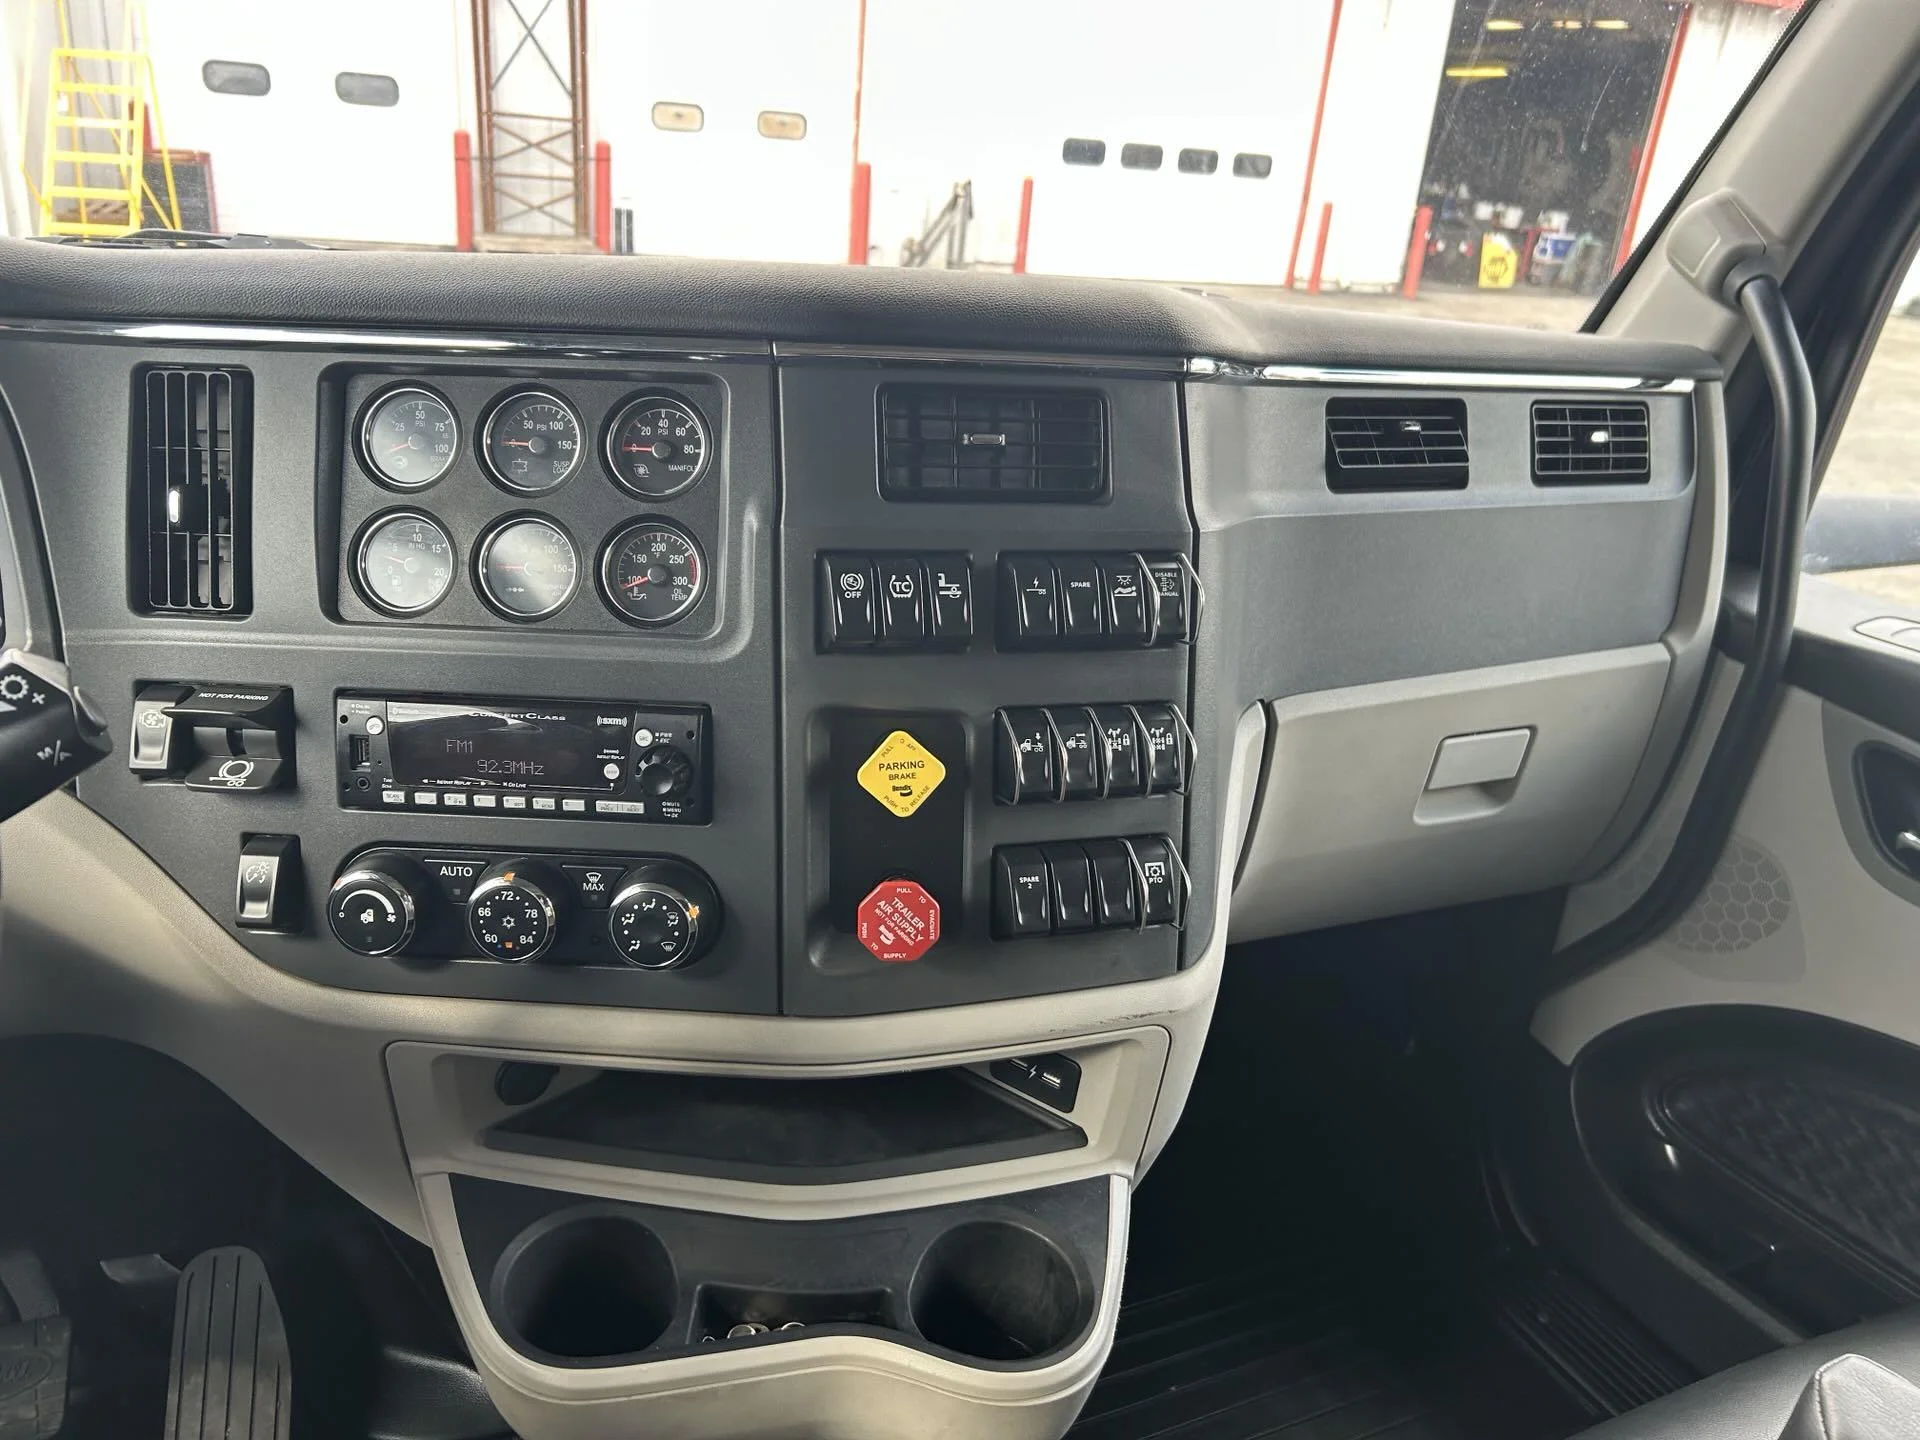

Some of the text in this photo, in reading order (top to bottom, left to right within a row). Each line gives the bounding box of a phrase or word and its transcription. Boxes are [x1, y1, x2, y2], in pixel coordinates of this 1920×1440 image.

[416, 410, 425, 419] 50
[394, 422, 405, 431] 25
[434, 422, 445, 431] 75
[523, 420, 533, 429] 50
[549, 421, 564, 430] 100
[658, 419, 669, 428] 40
[641, 426, 651, 436] 20
[657, 428, 669, 436] PSI
[675, 427, 686, 436] 60
[434, 444, 449, 453] 100
[557, 440, 572, 450] 150
[683, 444, 694, 454] 80
[412, 533, 422, 542] 10
[431, 544, 441, 553] 15
[543, 545, 559, 554] 100
[651, 543, 666, 552] 200
[632, 554, 647, 563] 150
[669, 555, 684, 564] 250
[433, 567, 444, 576] 20
[553, 564, 568, 573] 150
[672, 576, 688, 585] 300
[1070, 581, 1091, 589] SPARE
[893, 581, 910, 592] TC
[845, 590, 862, 599] OFF
[446, 739, 473, 753] FM1
[477, 759, 545, 775] 92.3MHz
[878, 760, 925, 772] PARKING
[888, 772, 916, 781] BRAKE
[883, 795, 899, 808] PUSH
[909, 784, 931, 807] RELEASE
[440, 865, 473, 877] AUTO
[1019, 875, 1040, 884] SPARE
[1149, 876, 1163, 884] PTO
[583, 882, 605, 891] MAX
[501, 891, 514, 900] 72
[918, 895, 926, 904] TO
[478, 907, 491, 917] 66
[524, 909, 538, 918] 78
[874, 907, 885, 919] NOT
[891, 896, 925, 931] TRAILER
[877, 900, 894, 915] AIR
[891, 913, 924, 942] SUPPLY
[484, 933, 498, 943] 60
[519, 935, 533, 944] 84
